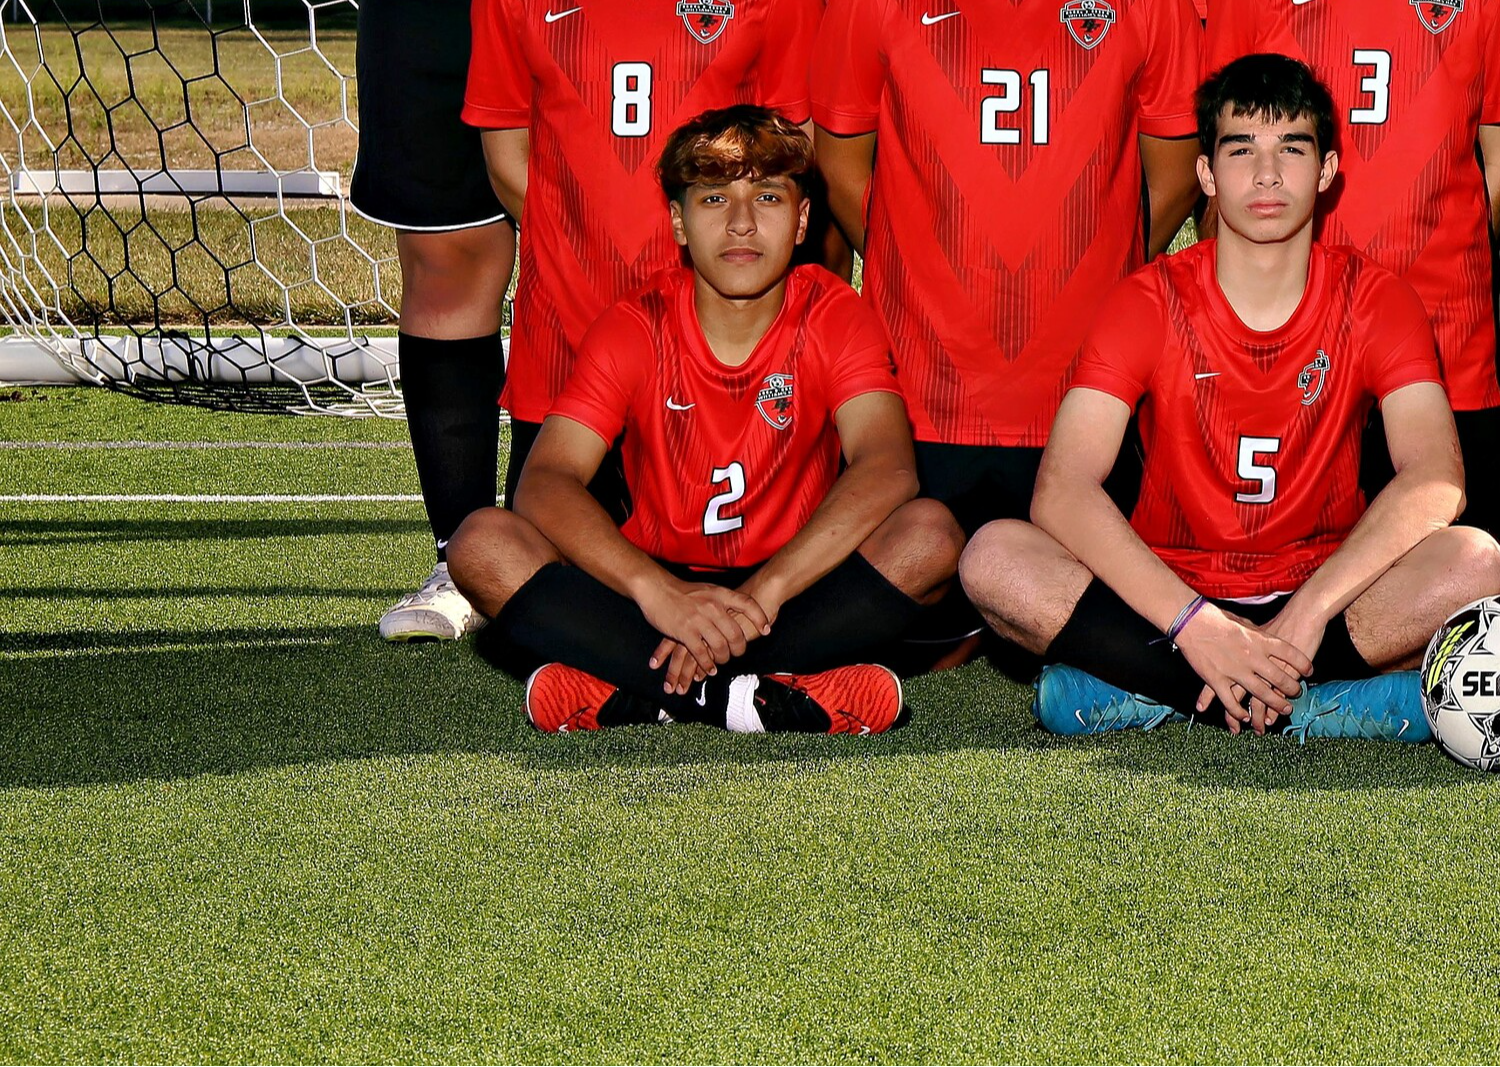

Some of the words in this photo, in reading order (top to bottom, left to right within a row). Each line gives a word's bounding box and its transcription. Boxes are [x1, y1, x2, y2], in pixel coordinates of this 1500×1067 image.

[610, 61, 653, 138] 8
[979, 67, 1050, 146] 21
[1348, 48, 1392, 126] 3
[701, 460, 747, 537] 2
[1234, 435, 1281, 505] 5
